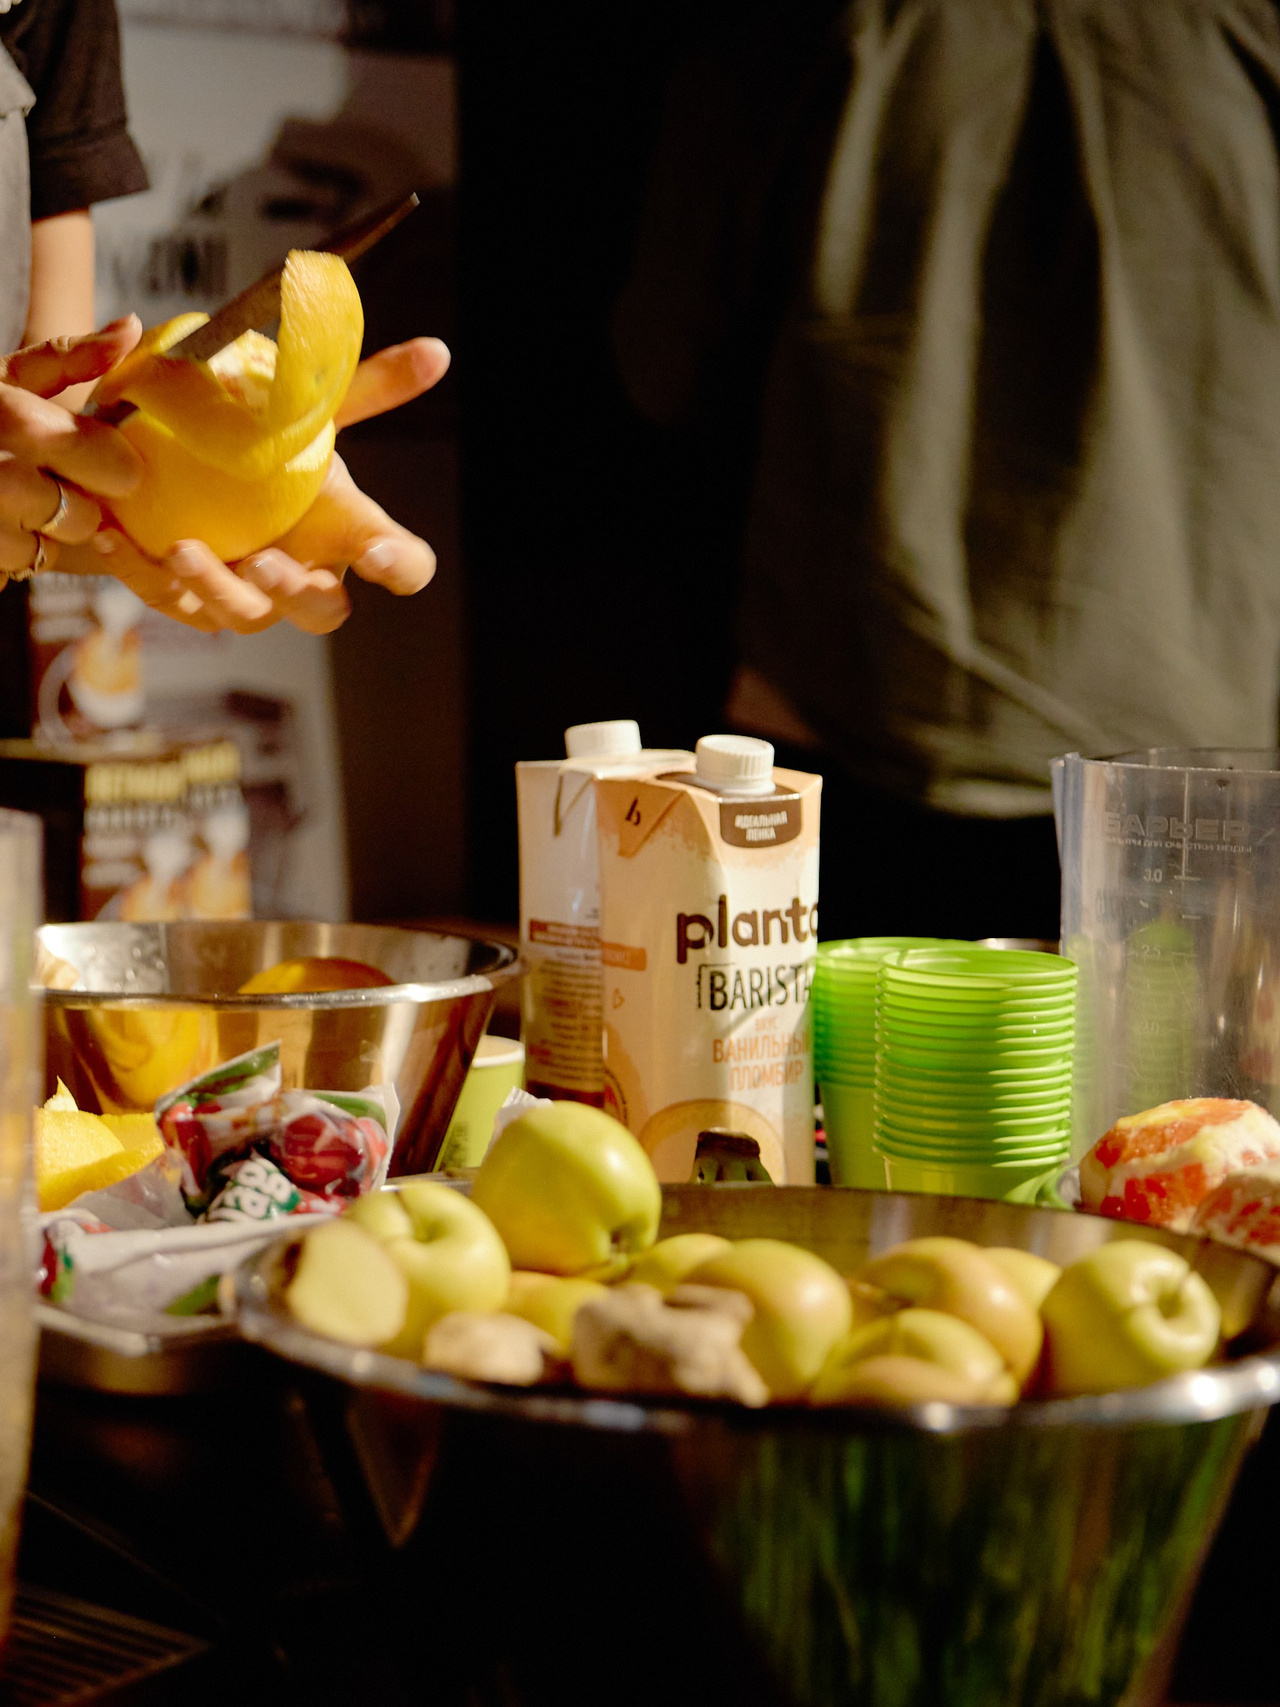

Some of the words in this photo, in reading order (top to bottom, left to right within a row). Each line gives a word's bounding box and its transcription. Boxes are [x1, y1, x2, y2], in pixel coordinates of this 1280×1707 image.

[734, 810, 788, 829] ИДЕАЛЬНАЯ
[1102, 811, 1252, 842] БАРЬЕР
[745, 826, 776, 842] ПЕНКА
[1142, 867, 1164, 884] 3.0
[730, 1059, 804, 1091] ПЛОМБИР
